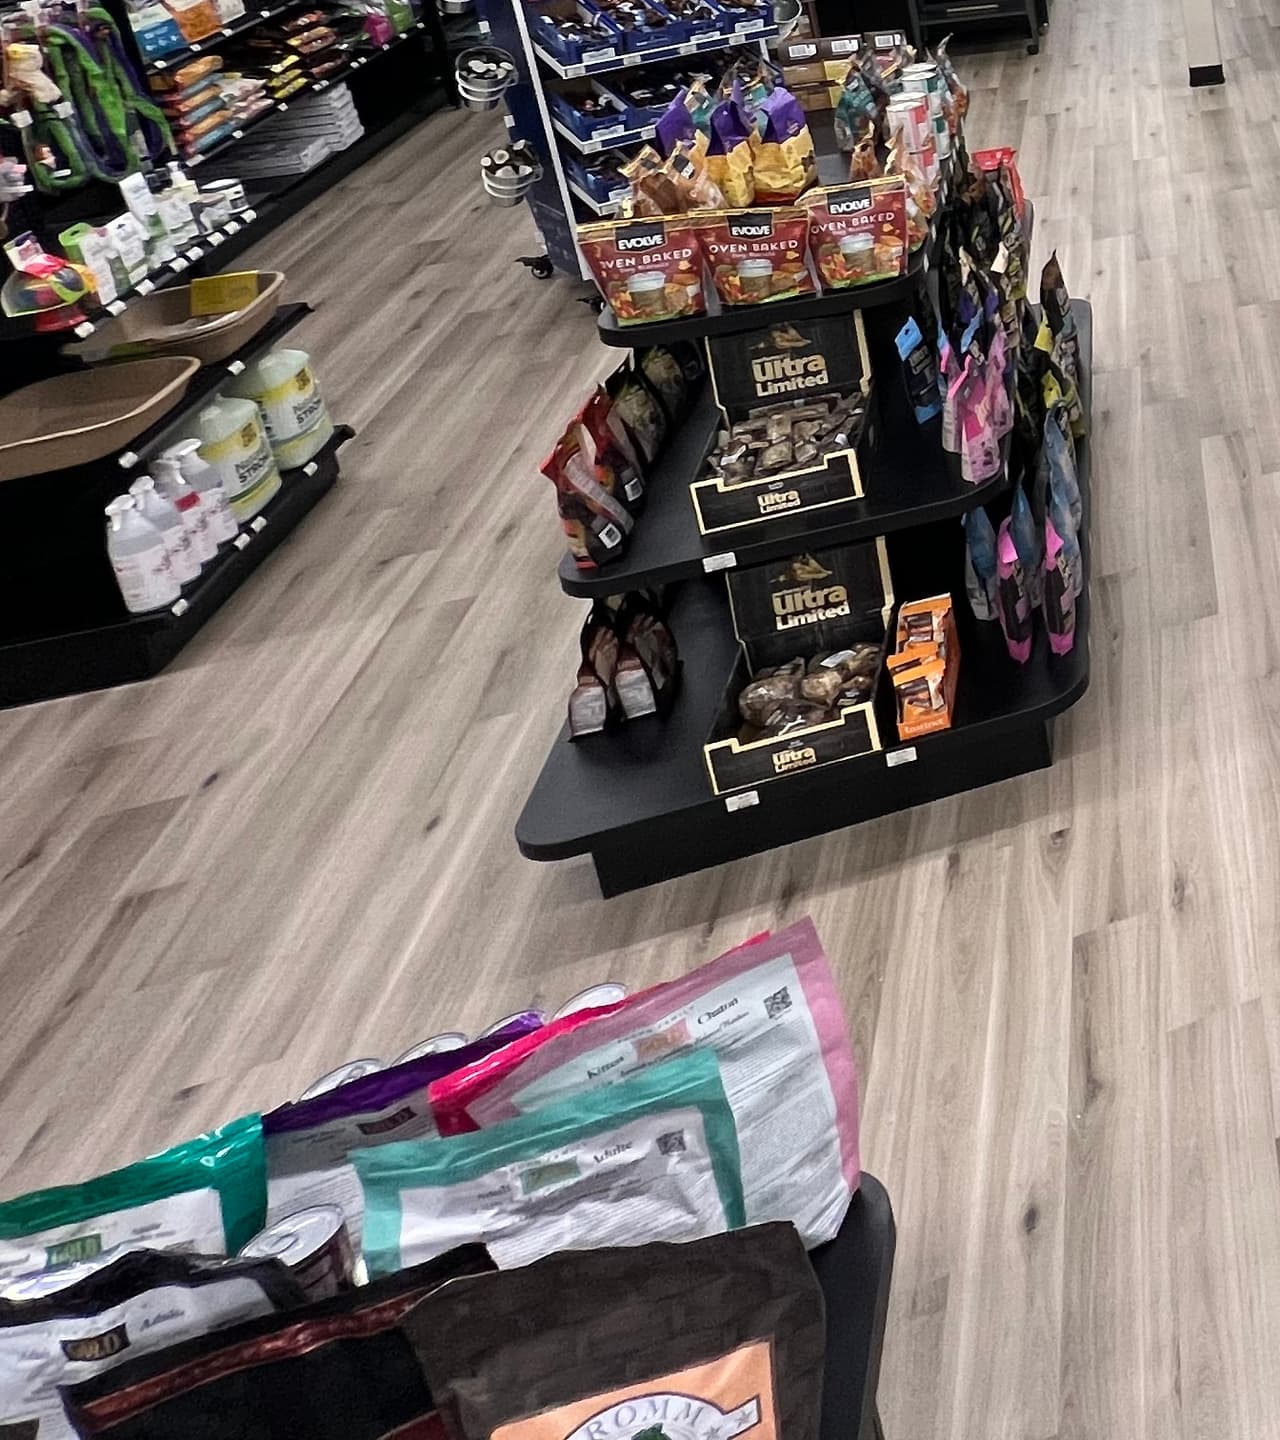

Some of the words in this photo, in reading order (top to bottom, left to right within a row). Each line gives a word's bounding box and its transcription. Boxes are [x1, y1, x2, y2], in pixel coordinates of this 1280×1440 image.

[830, 198, 871, 215] EVOLVE
[731, 224, 771, 237] EVOLVE
[811, 221, 846, 235] OVEN
[851, 212, 895, 227] BAKED
[618, 233, 664, 251] EVOLVE
[709, 243, 748, 255] OVEN
[752, 239, 799, 252] BAKED
[644, 248, 692, 265] BAKED
[751, 354, 826, 383] Ultra
[756, 371, 829, 398] Limited
[757, 490, 799, 507] Ultra
[771, 585, 848, 616] Ultra
[775, 601, 850, 631] Limited
[771, 747, 816, 766] Ultra
[586, 1397, 706, 1440] ROMM
